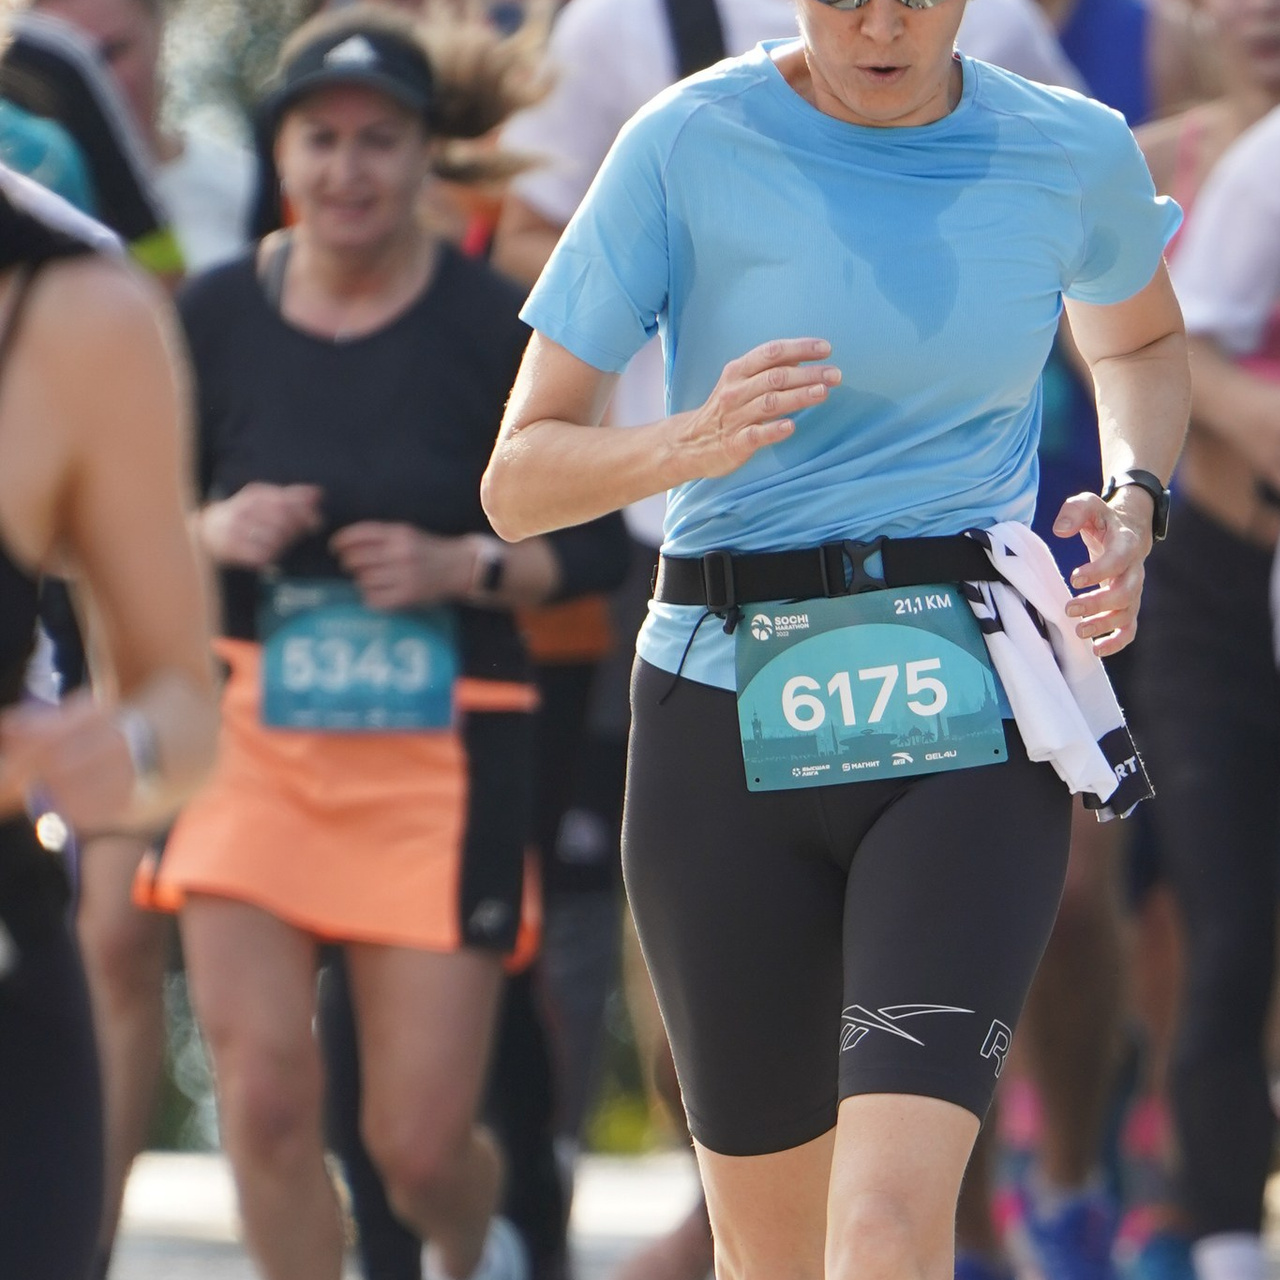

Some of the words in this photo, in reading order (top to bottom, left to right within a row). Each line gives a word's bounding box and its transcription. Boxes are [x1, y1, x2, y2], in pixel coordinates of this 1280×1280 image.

[894, 596, 923, 615] 21,1
[926, 593, 952, 610] KM
[774, 613, 809, 626] SOCHI
[775, 622, 810, 631] MARATHON
[282, 637, 431, 694] 5343
[781, 657, 949, 732] 6175
[925, 749, 957, 761] GEL4U
[851, 760, 880, 770] МАГНИТ
